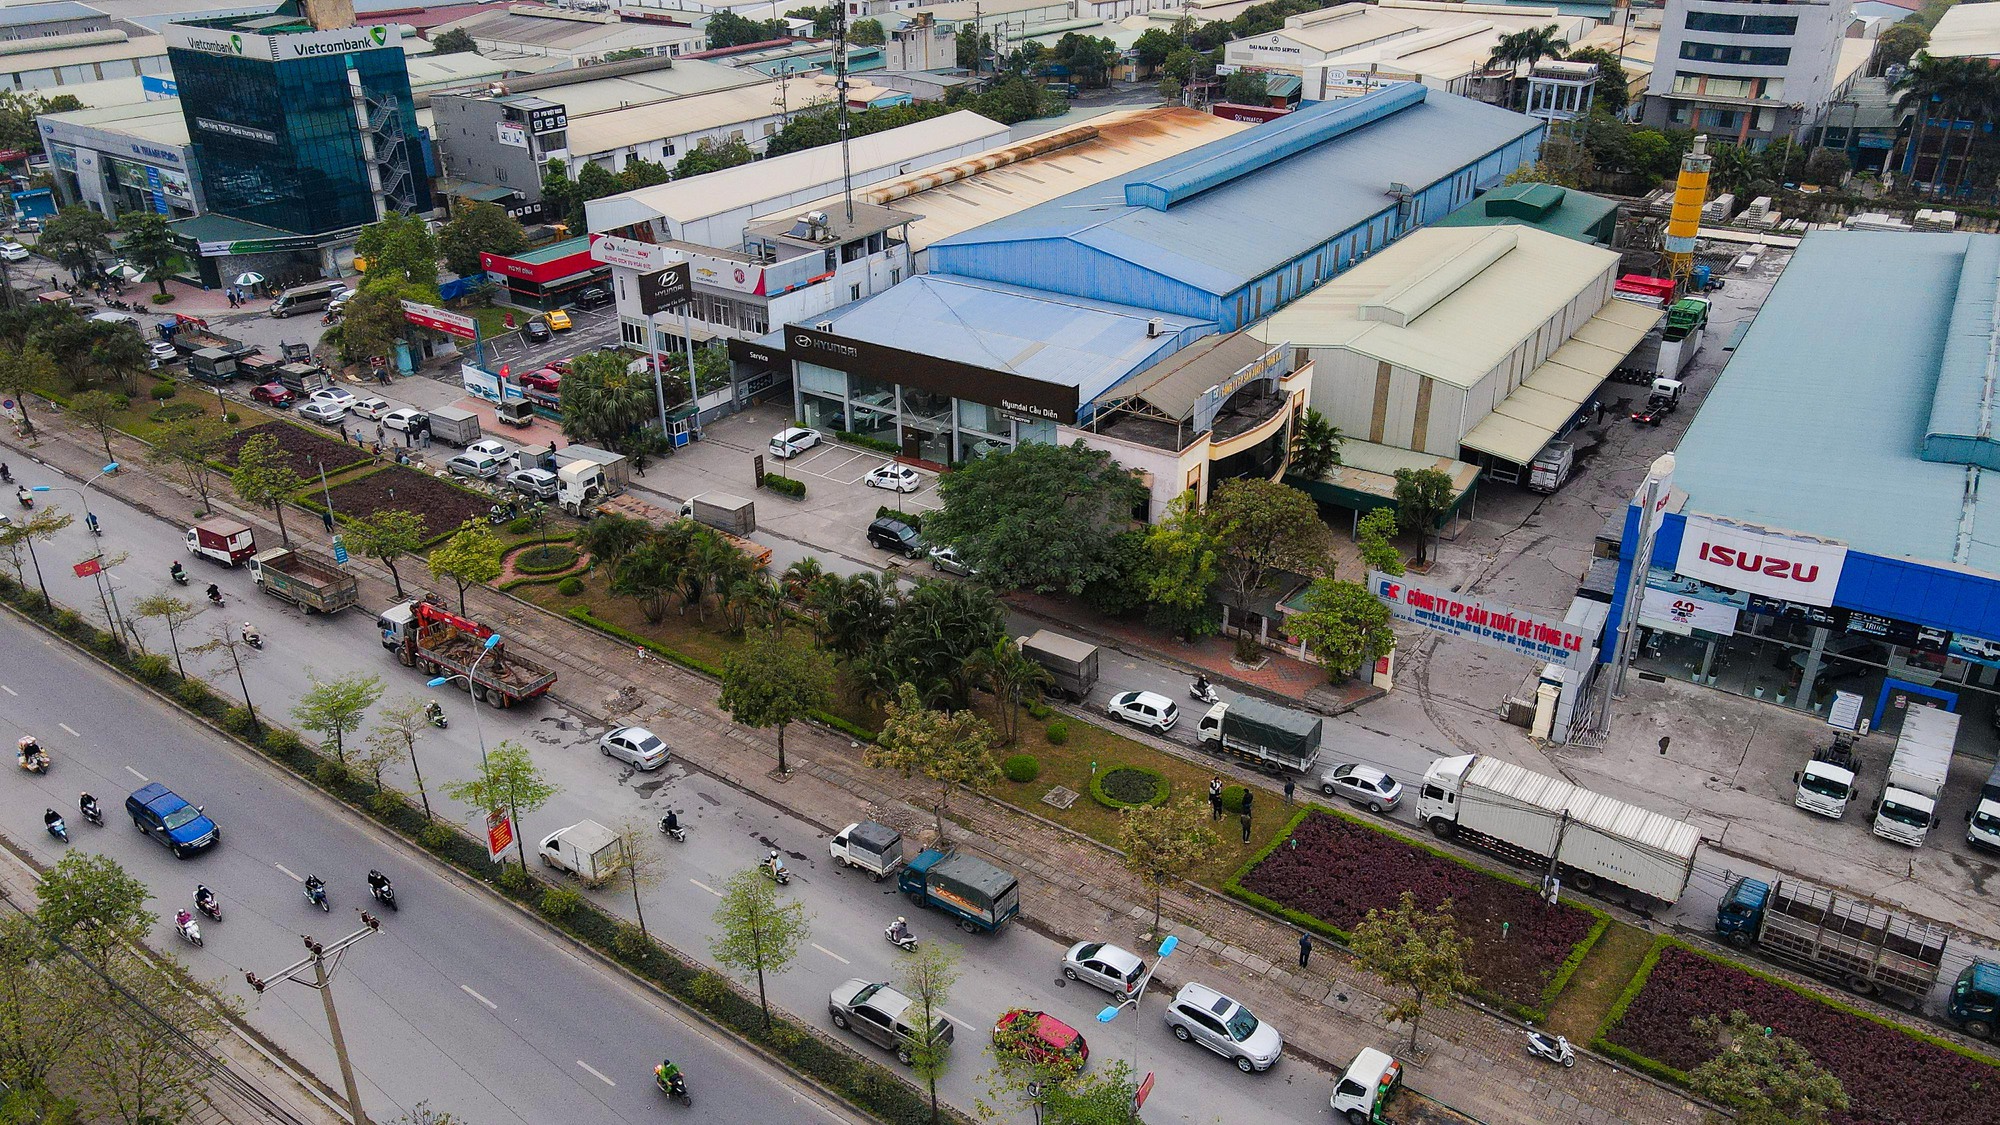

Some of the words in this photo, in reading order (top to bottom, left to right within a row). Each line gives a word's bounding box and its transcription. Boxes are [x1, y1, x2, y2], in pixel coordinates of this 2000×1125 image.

[187, 36, 235, 55] Vietcombank
[293, 37, 373, 56] Vietcombank
[654, 284, 684, 297] HYUNDAI
[749, 351, 769, 362] Service
[813, 338, 858, 358] HYUNDAI
[1002, 399, 1028, 412] Hyundai
[1029, 405, 1042, 415] Cầu
[1699, 542, 1819, 583] ISUZU
[1406, 588, 1434, 611] CÔNG
[1435, 597, 1449, 614] TY
[1449, 601, 1464, 618] CP
[1465, 602, 1488, 626] SẢN
[1489, 612, 1517, 634] XUẤT
[1517, 619, 1533, 638] BÊ
[1533, 623, 1561, 646] TÔNG
[1563, 633, 1584, 652] C.K
[1849, 612, 1891, 627] ISUZU
[1415, 608, 1440, 623] CHUYÊN
[1440, 615, 1455, 628] SẢN
[1455, 620, 1472, 632] XUẤT
[1472, 624, 1481, 635] VÀ
[1482, 626, 1492, 637] ÉP
[1492, 631, 1507, 642] CỌC
[1507, 635, 1517, 645] BÊ
[1517, 636, 1536, 650] TÔNG
[1537, 641, 1551, 654] CỐT
[1551, 646, 1570, 659] THÉP
